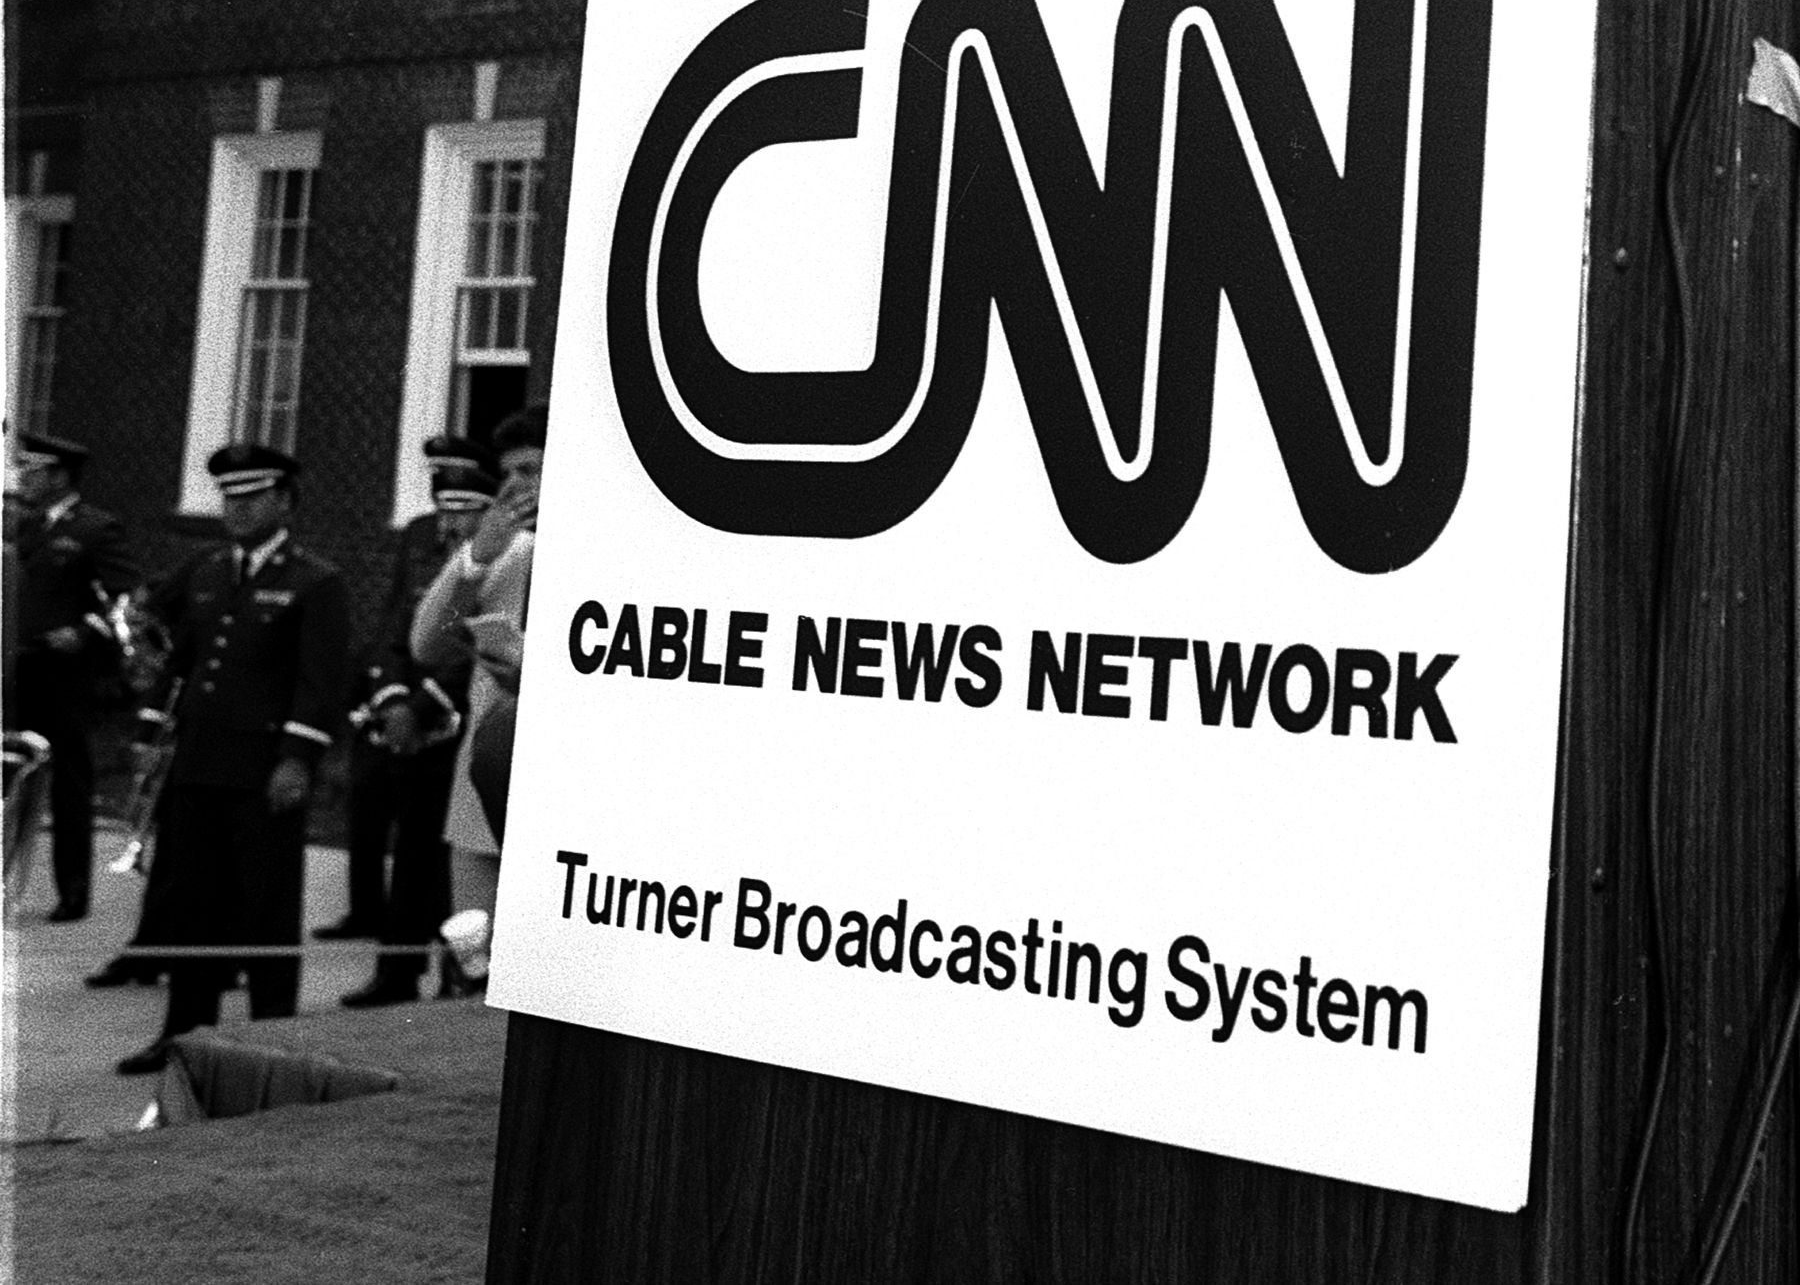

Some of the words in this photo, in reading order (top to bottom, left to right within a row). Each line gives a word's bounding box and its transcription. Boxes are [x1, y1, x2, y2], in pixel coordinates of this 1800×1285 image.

[568, 600, 769, 688] CABLE
[791, 615, 1003, 708] NEWS
[1026, 630, 1460, 744] NETWORK
[556, 850, 723, 942] Turner
[733, 877, 1148, 1028] Broadcasting
[1164, 934, 1428, 1054] System
